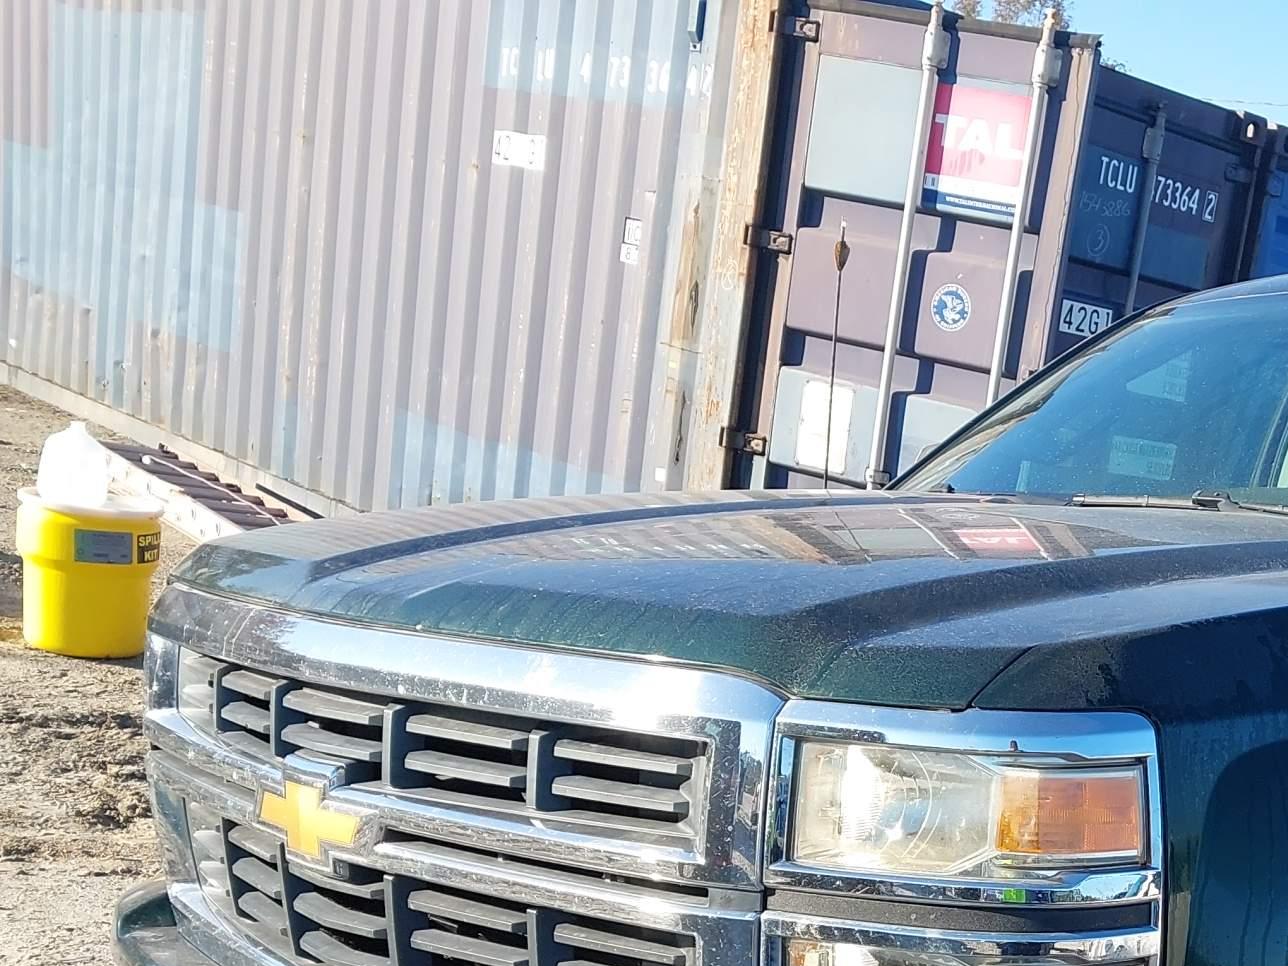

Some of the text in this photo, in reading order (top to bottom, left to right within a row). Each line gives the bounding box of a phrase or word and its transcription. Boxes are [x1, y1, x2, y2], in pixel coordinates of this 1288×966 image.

[935, 113, 1023, 160] TAL
[1099, 156, 1217, 219] TCLU 73364 2
[1063, 303, 1110, 335] 42G1
[144, 549, 158, 561] KIT
